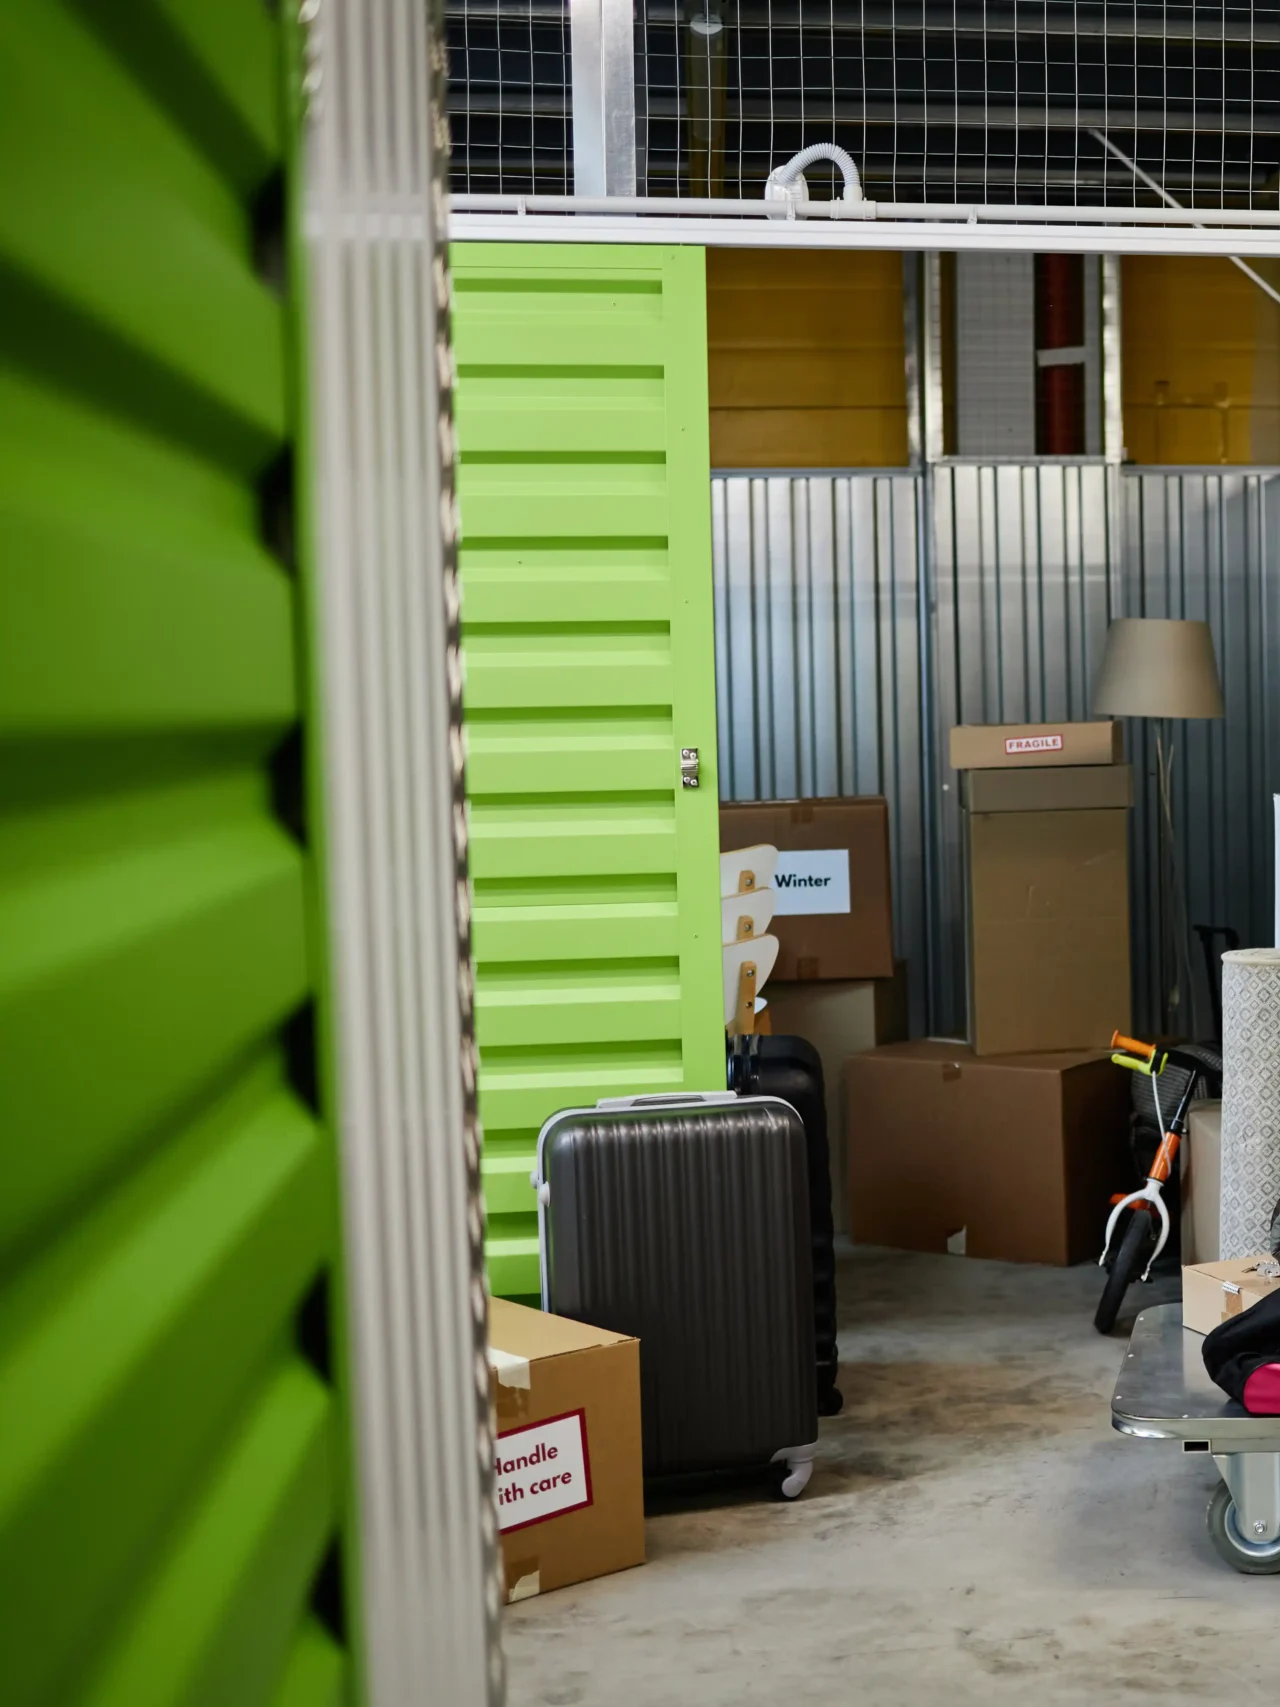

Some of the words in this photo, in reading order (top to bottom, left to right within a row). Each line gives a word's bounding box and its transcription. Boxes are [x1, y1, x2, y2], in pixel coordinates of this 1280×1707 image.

[1008, 739, 1059, 750] FRAGILE
[774, 873, 832, 888] Winter
[498, 1482, 525, 1506] ith
[530, 1472, 573, 1496] care
